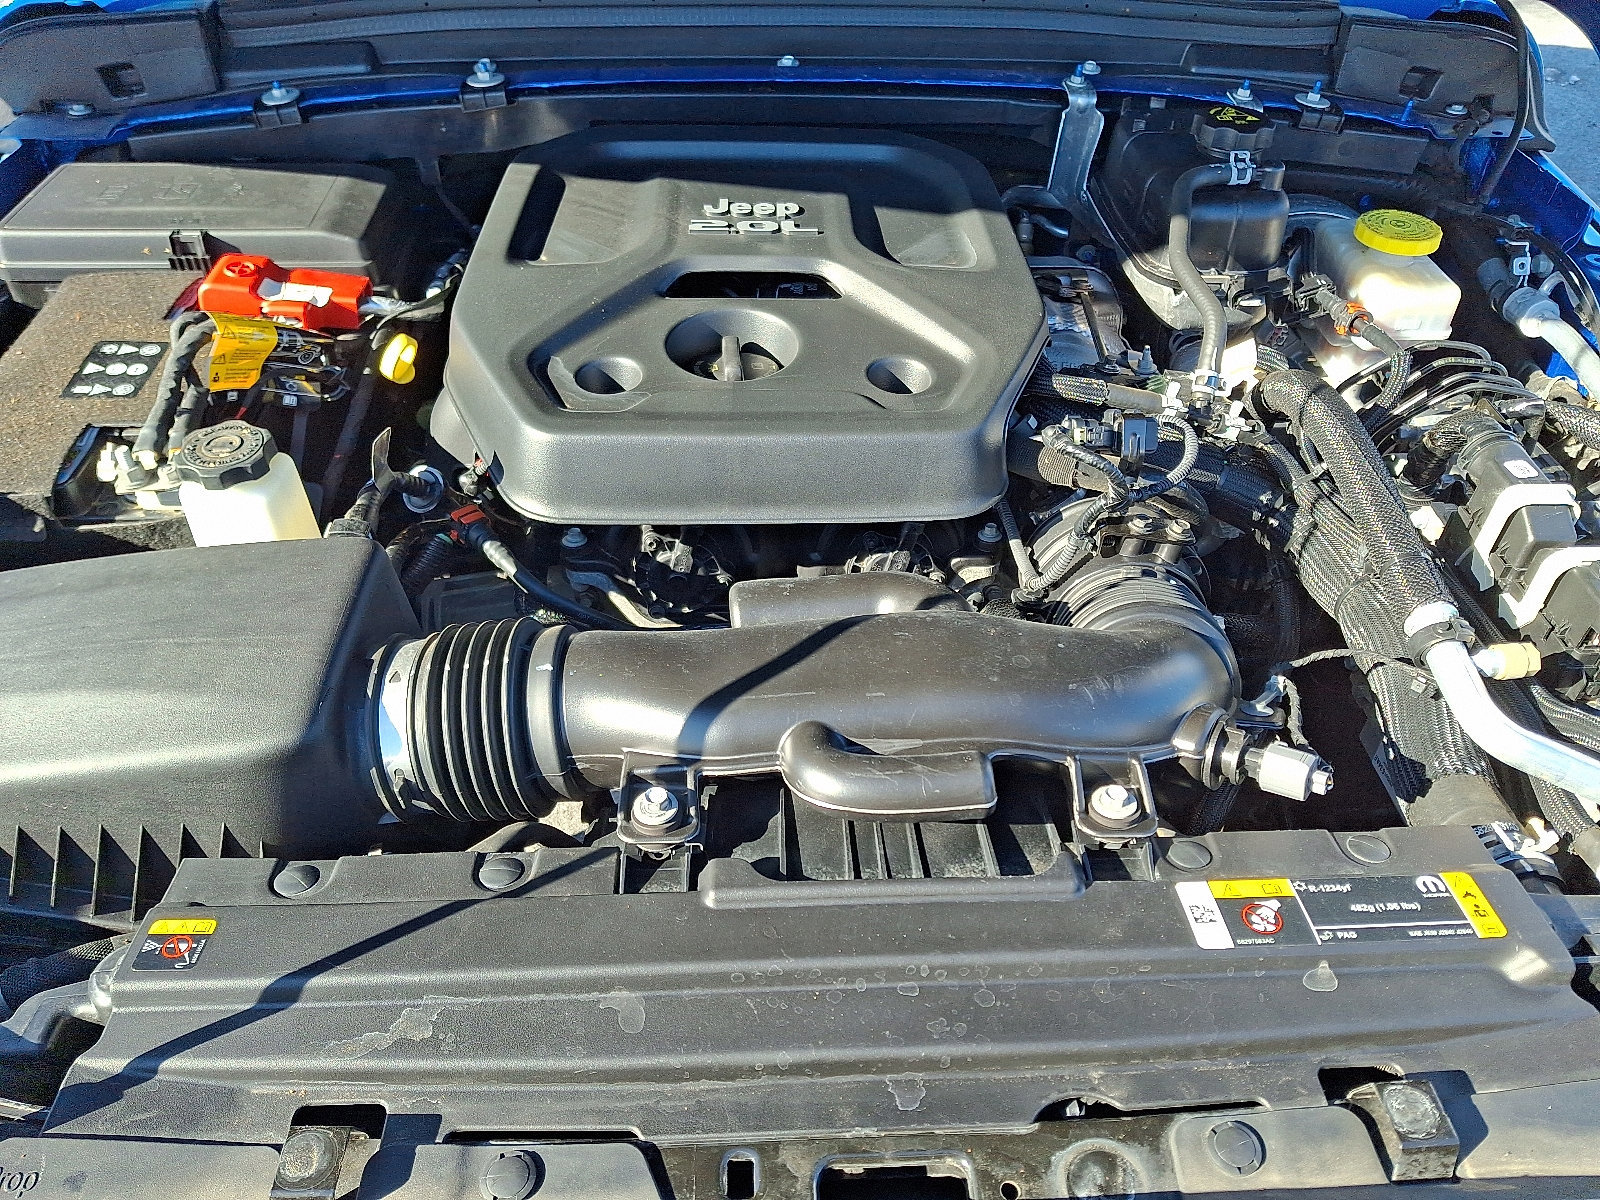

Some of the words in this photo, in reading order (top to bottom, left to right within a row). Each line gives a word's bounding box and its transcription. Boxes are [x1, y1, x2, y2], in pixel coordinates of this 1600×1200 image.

[703, 198, 801, 220] Jeep
[688, 219, 819, 235] 2.0L
[0, 1166, 40, 1199] rop
